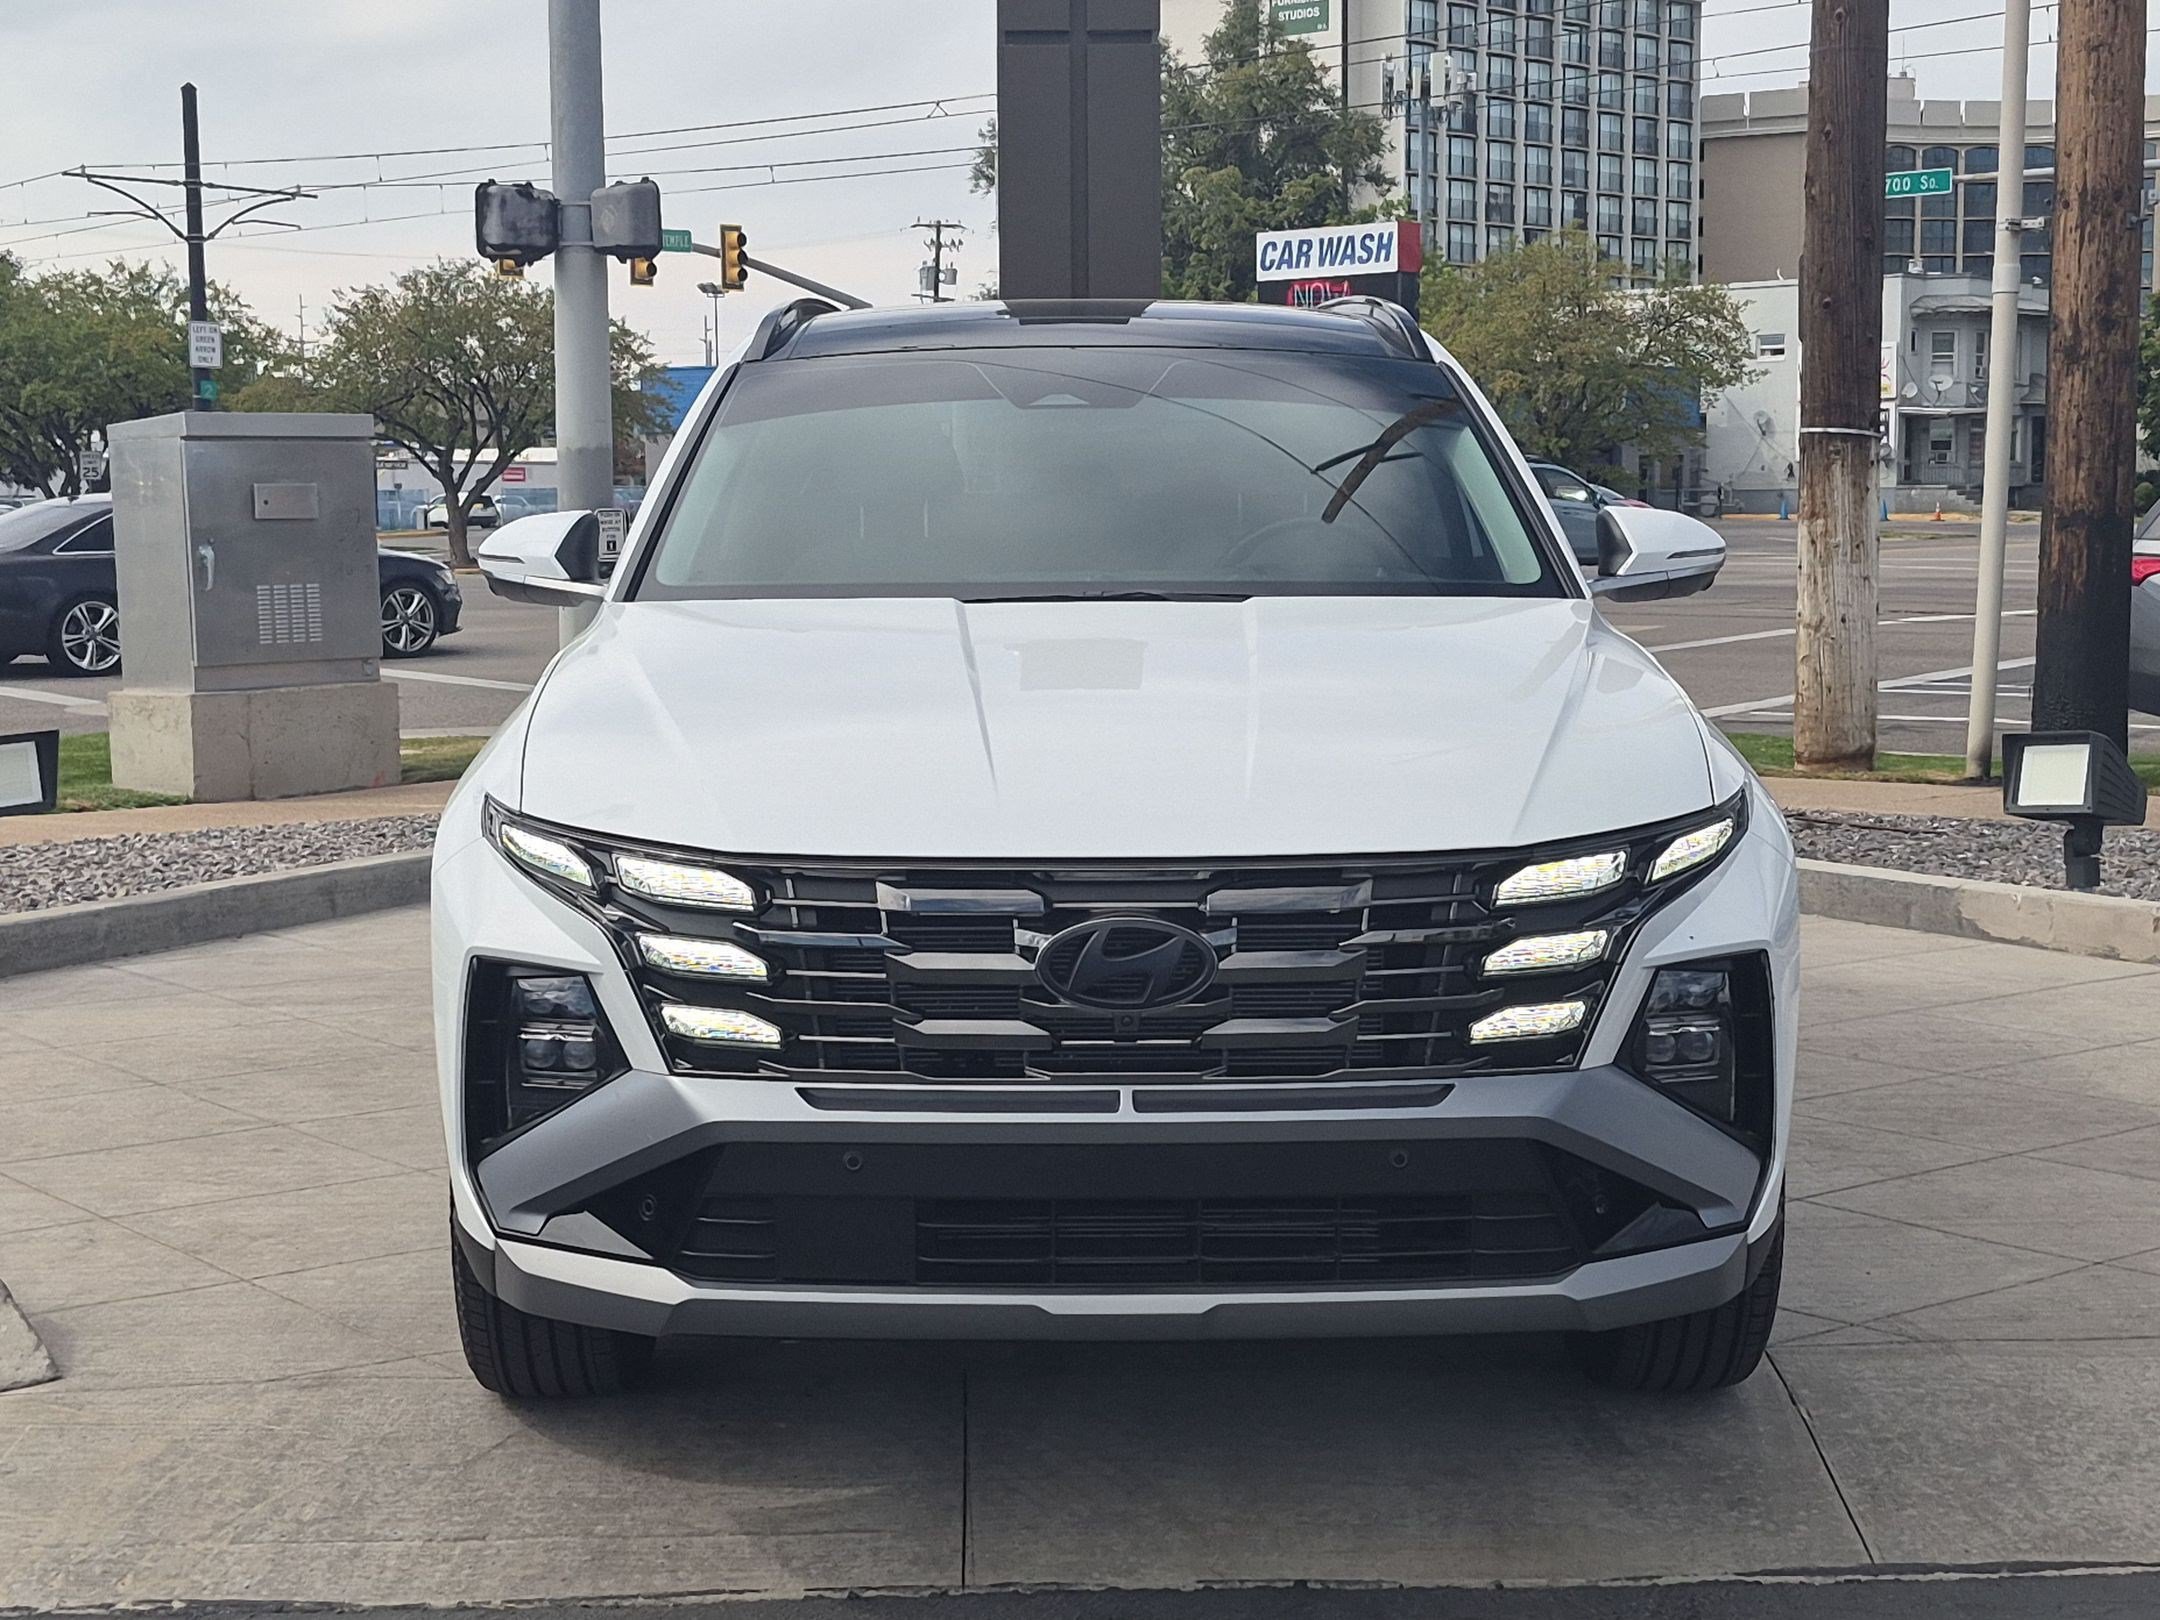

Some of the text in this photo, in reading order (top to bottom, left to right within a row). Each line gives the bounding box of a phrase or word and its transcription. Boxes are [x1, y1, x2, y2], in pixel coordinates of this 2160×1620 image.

[1278, 7, 1321, 22] STUDIOS
[1885, 175, 1939, 193] 700 So.
[1260, 231, 1394, 271] CAR WASH
[82, 466, 99, 478] 25
